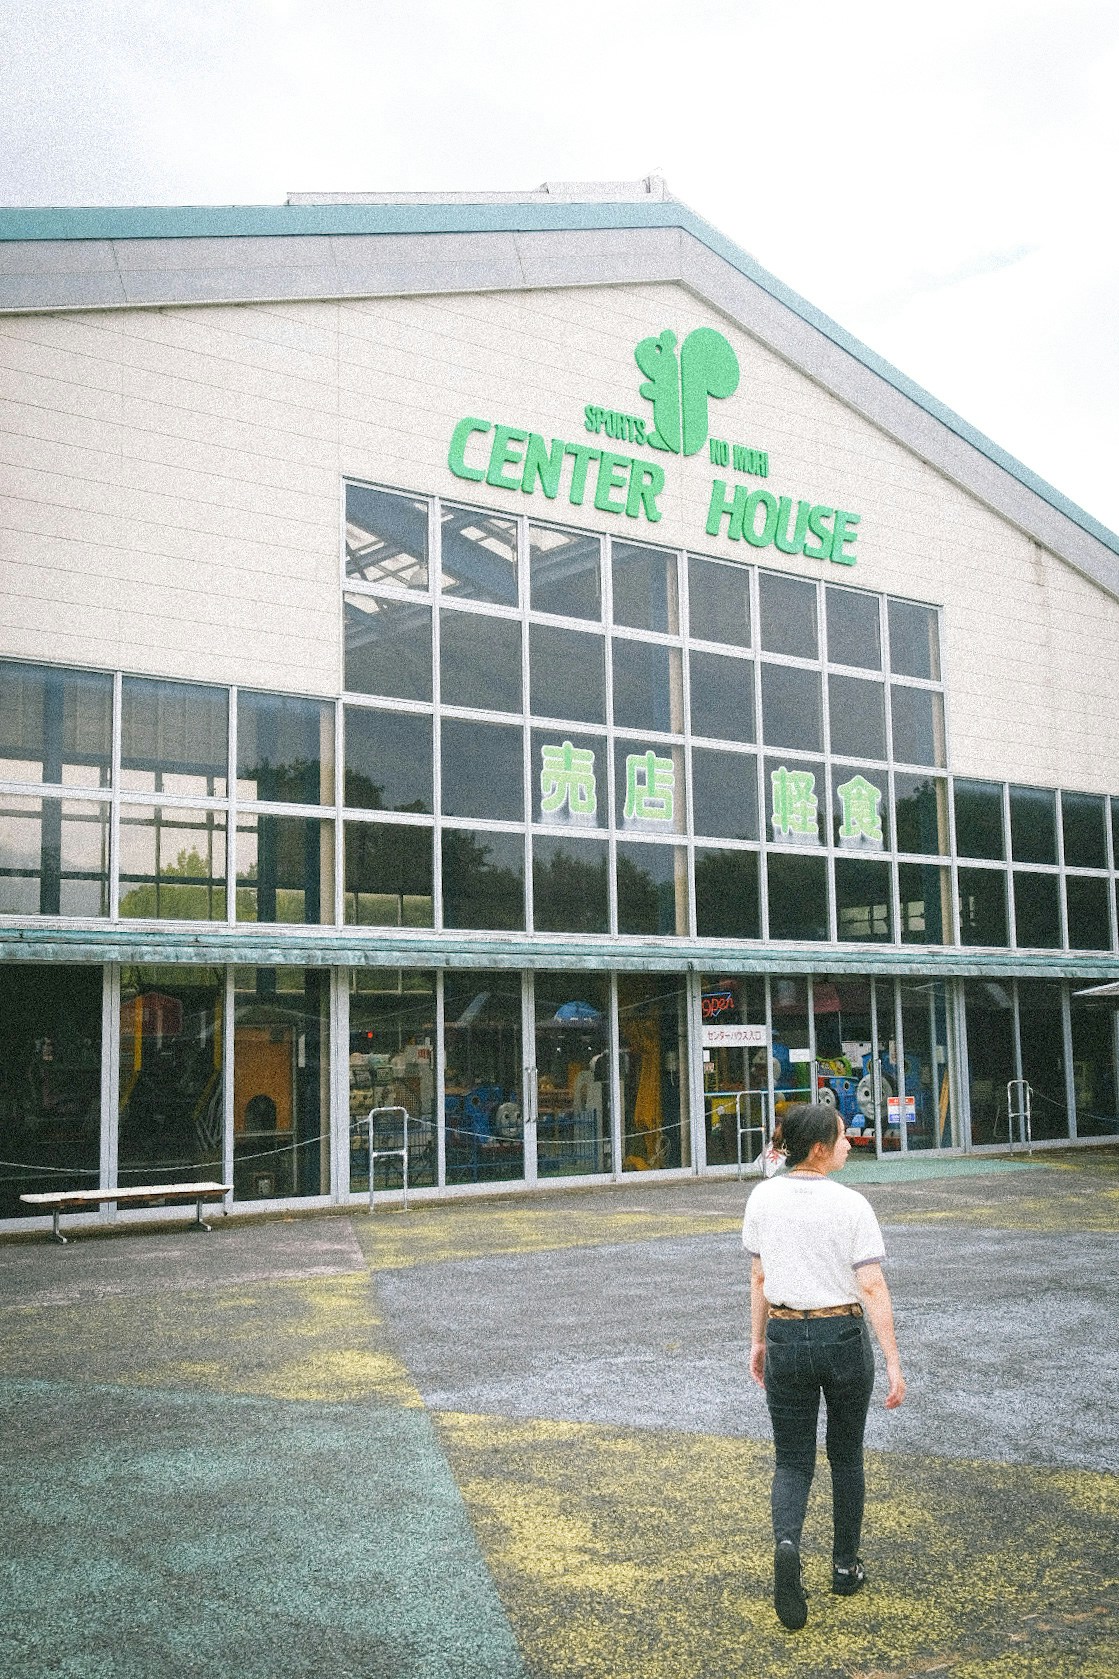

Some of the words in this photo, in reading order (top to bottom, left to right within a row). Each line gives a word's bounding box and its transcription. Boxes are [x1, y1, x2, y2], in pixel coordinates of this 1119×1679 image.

[585, 404, 646, 446] SPORTS
[709, 438, 730, 468] NO
[733, 444, 769, 478] MORI
[448, 417, 665, 522] CENTER
[706, 479, 861, 566] HOUSE
[541, 741, 676, 822] 売店
[771, 766, 882, 841] 軽食
[708, 1031, 761, 1041] センターハウス入口
